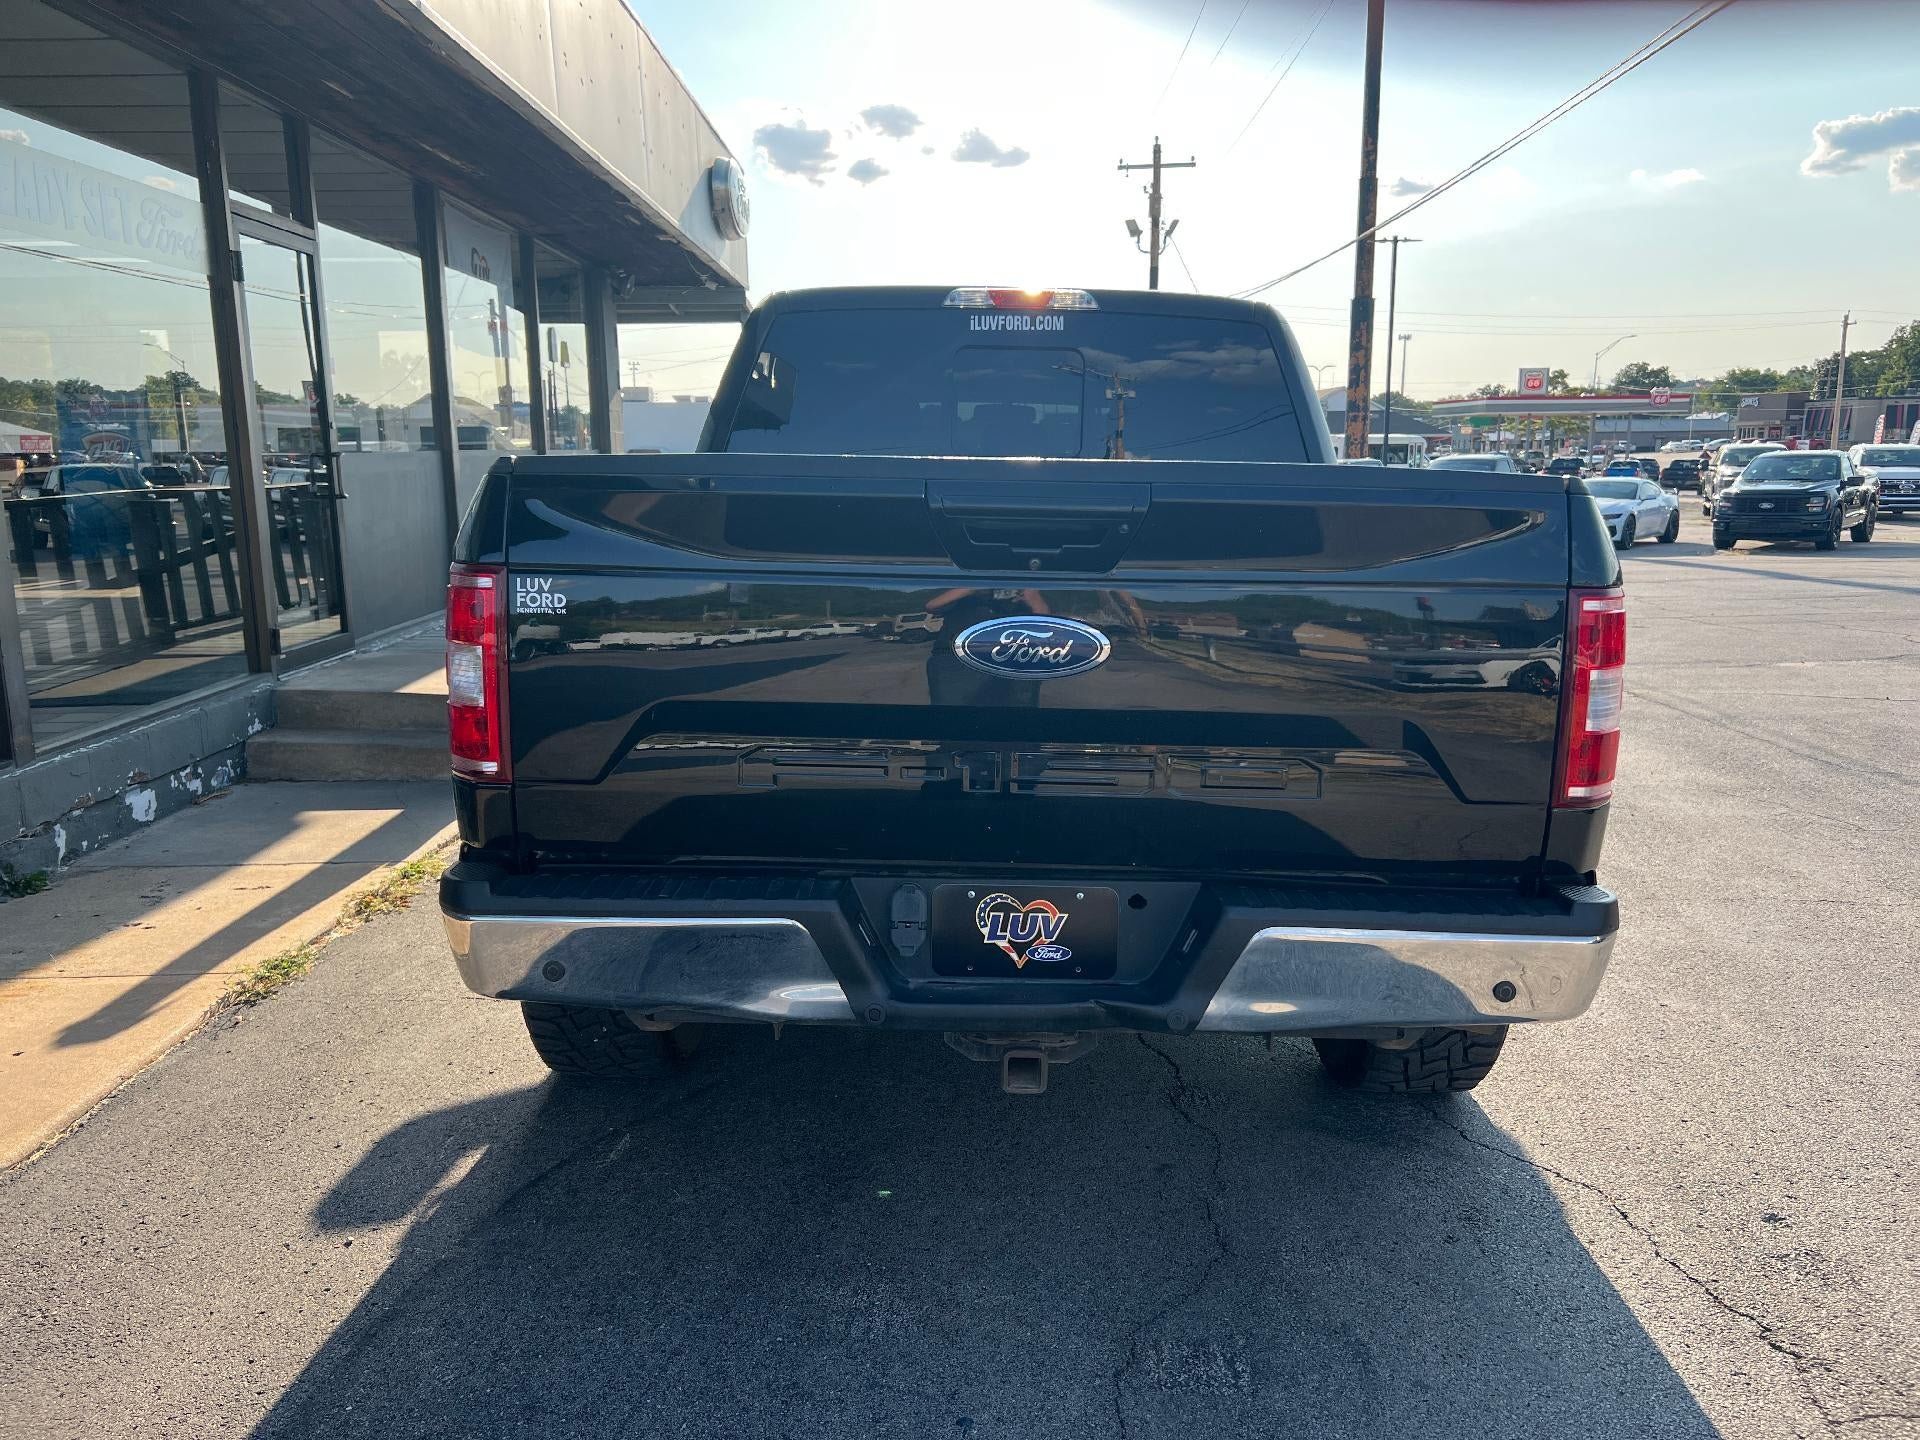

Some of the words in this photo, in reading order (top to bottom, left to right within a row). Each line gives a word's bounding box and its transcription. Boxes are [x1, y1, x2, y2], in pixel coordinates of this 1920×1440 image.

[970, 315, 1064, 331] iLUVFORD.COM
[516, 577, 553, 592] LUV
[516, 592, 567, 608] FORD
[991, 629, 1074, 664] Ford
[984, 911, 1069, 944] LUV
[1034, 946, 1063, 960] Ford
